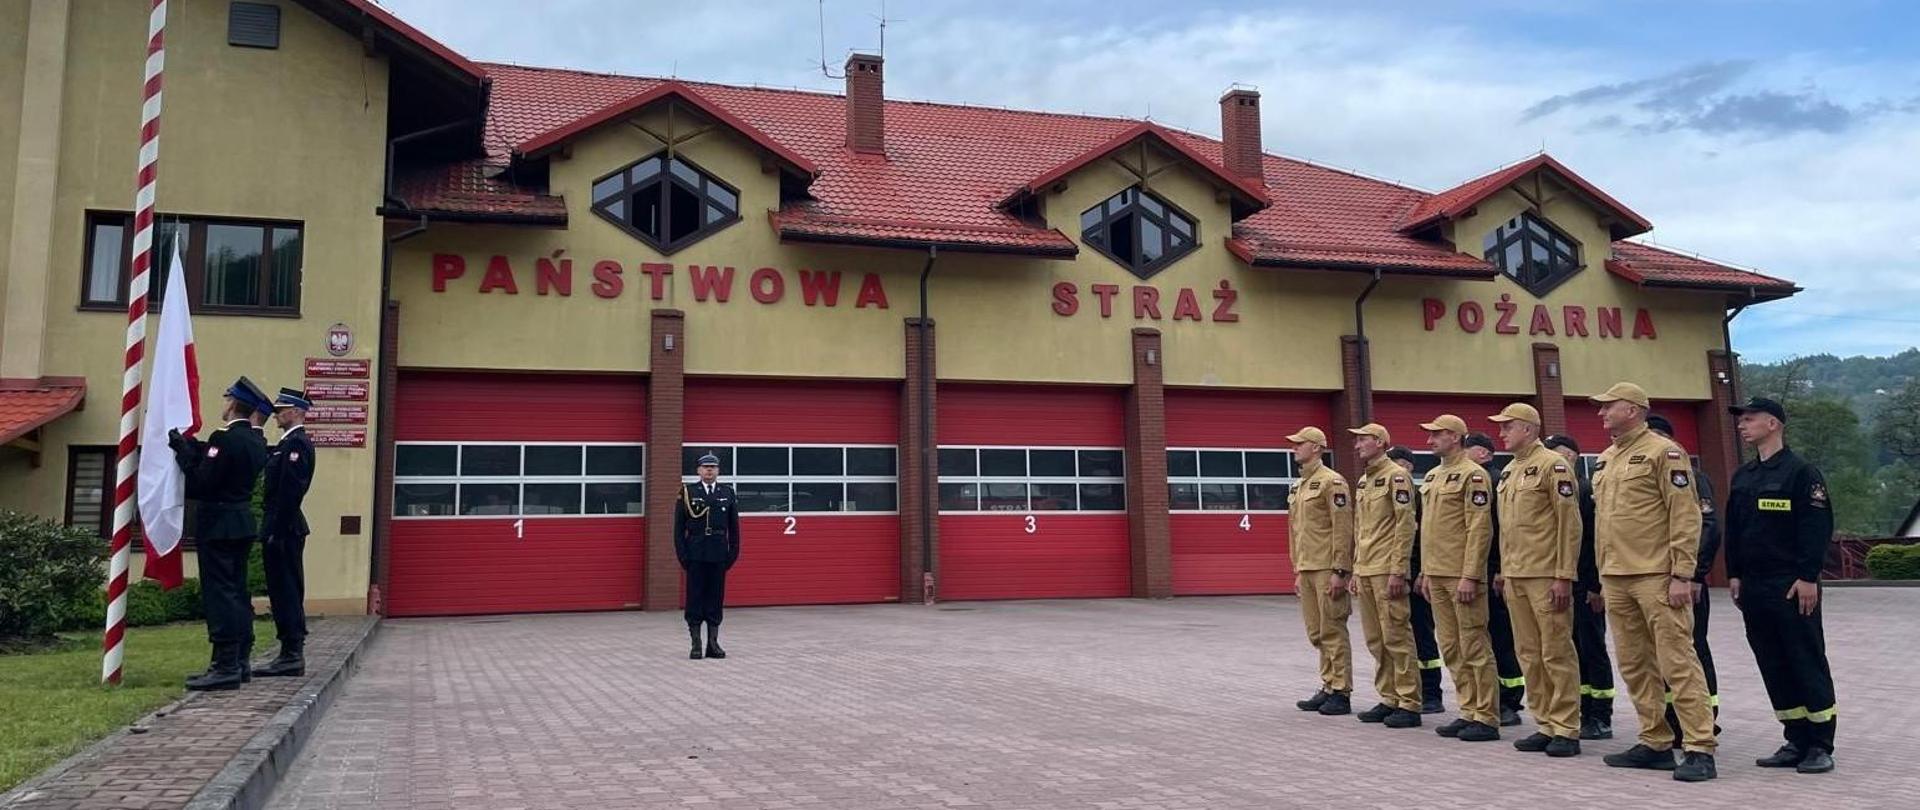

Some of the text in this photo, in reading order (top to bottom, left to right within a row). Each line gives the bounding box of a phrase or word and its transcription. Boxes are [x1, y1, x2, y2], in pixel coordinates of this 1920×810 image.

[432, 249, 1657, 339] PAŃSTWOWA STRAŻ POŻARNA
[513, 519, 523, 538] 1
[784, 517, 796, 535] 2
[1025, 515, 1036, 533] 3
[1240, 514, 1251, 531] 4
